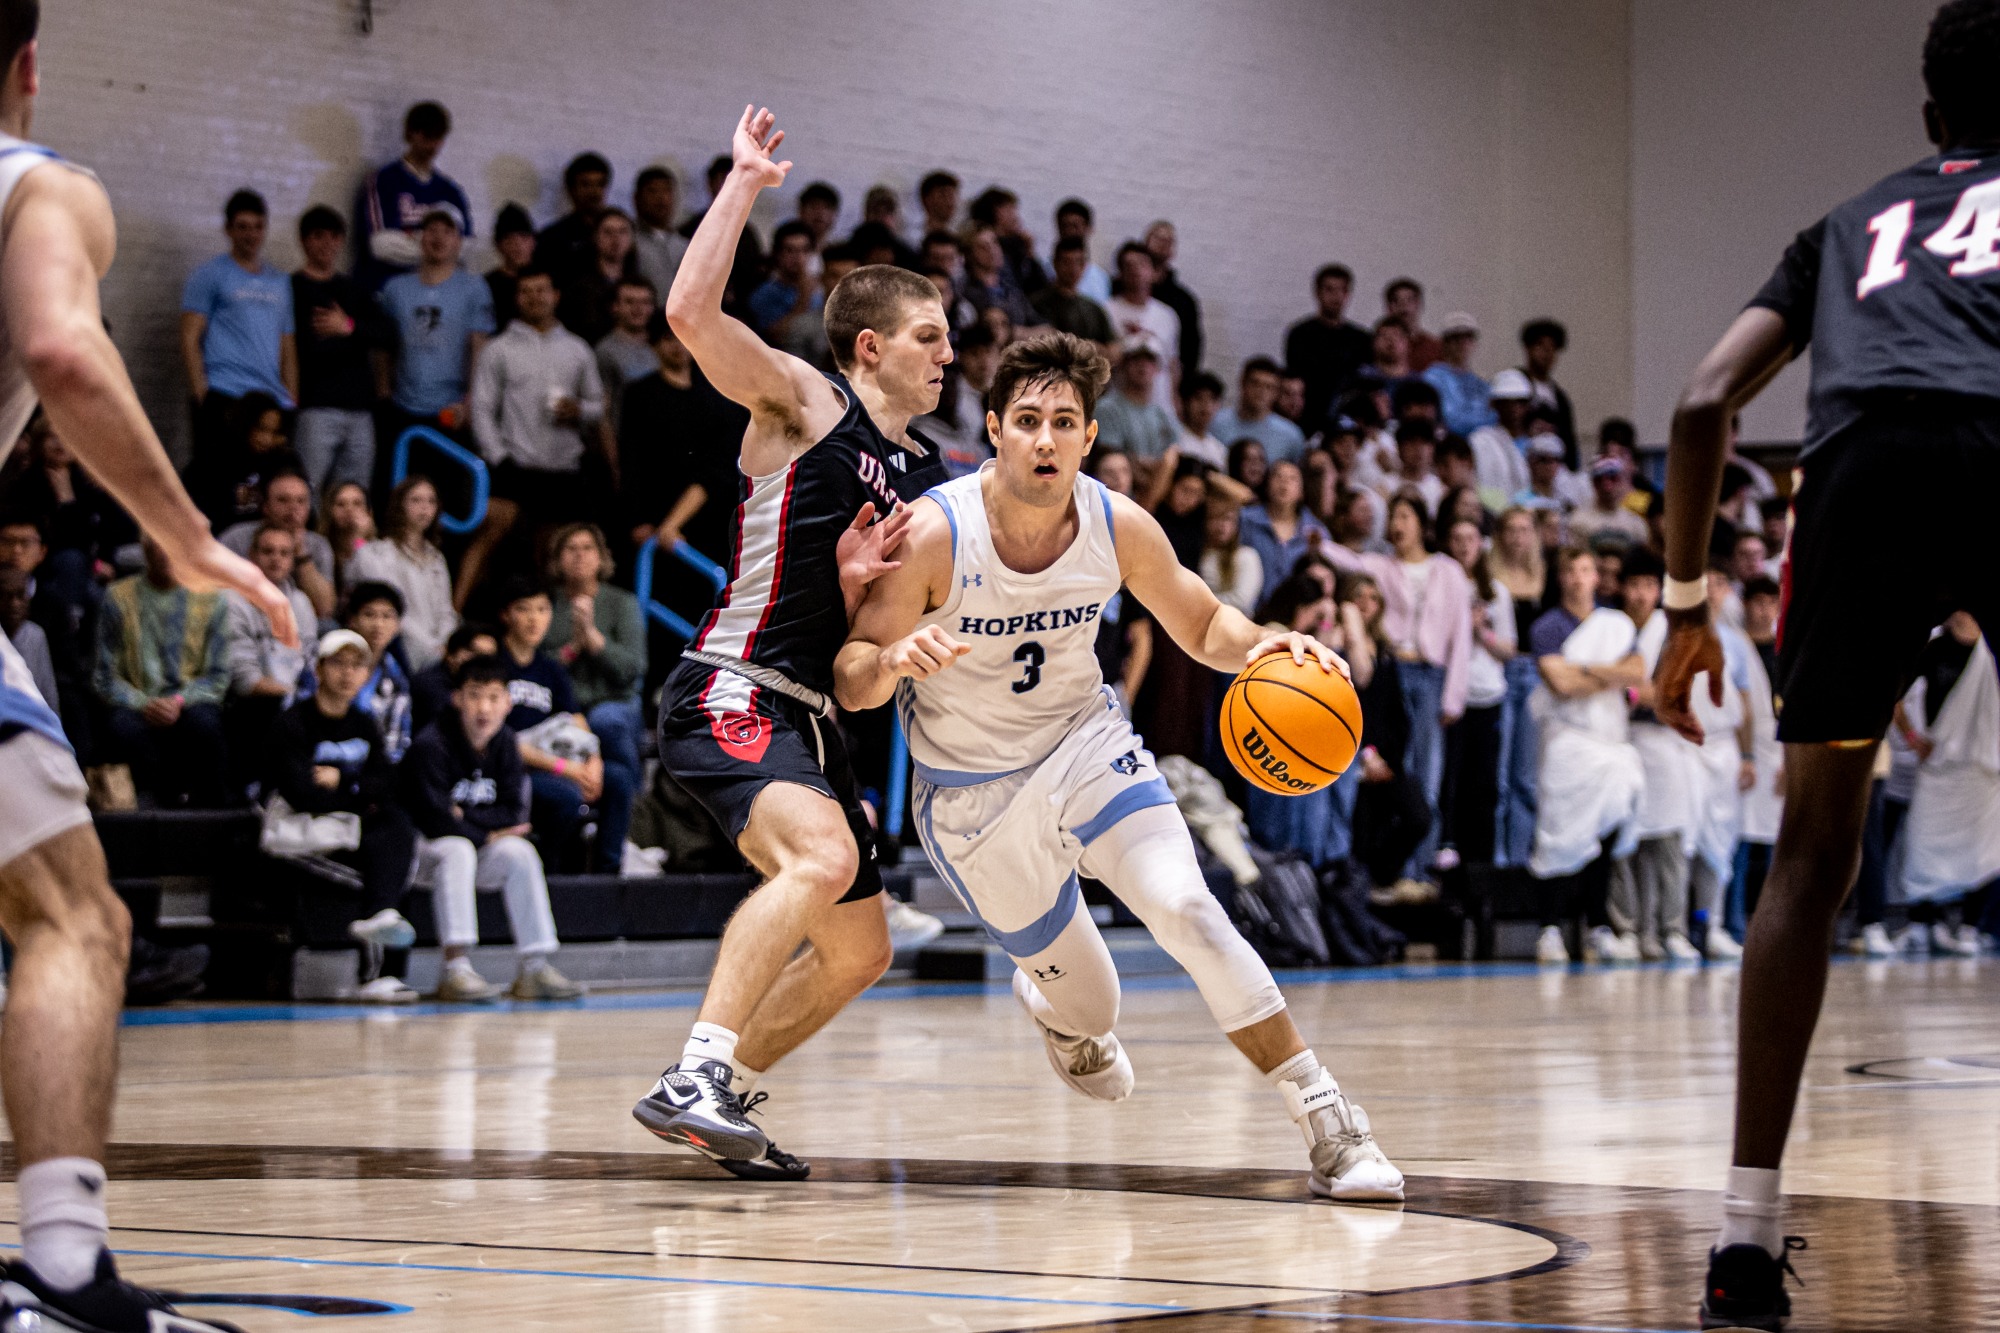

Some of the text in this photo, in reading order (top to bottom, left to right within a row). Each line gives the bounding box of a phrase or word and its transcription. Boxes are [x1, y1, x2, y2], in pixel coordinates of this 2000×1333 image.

[1857, 174, 2000, 300] 14
[959, 602, 1101, 636] HOPKINS
[1011, 640, 1046, 695] 3
[1242, 726, 1317, 791] Wilson
